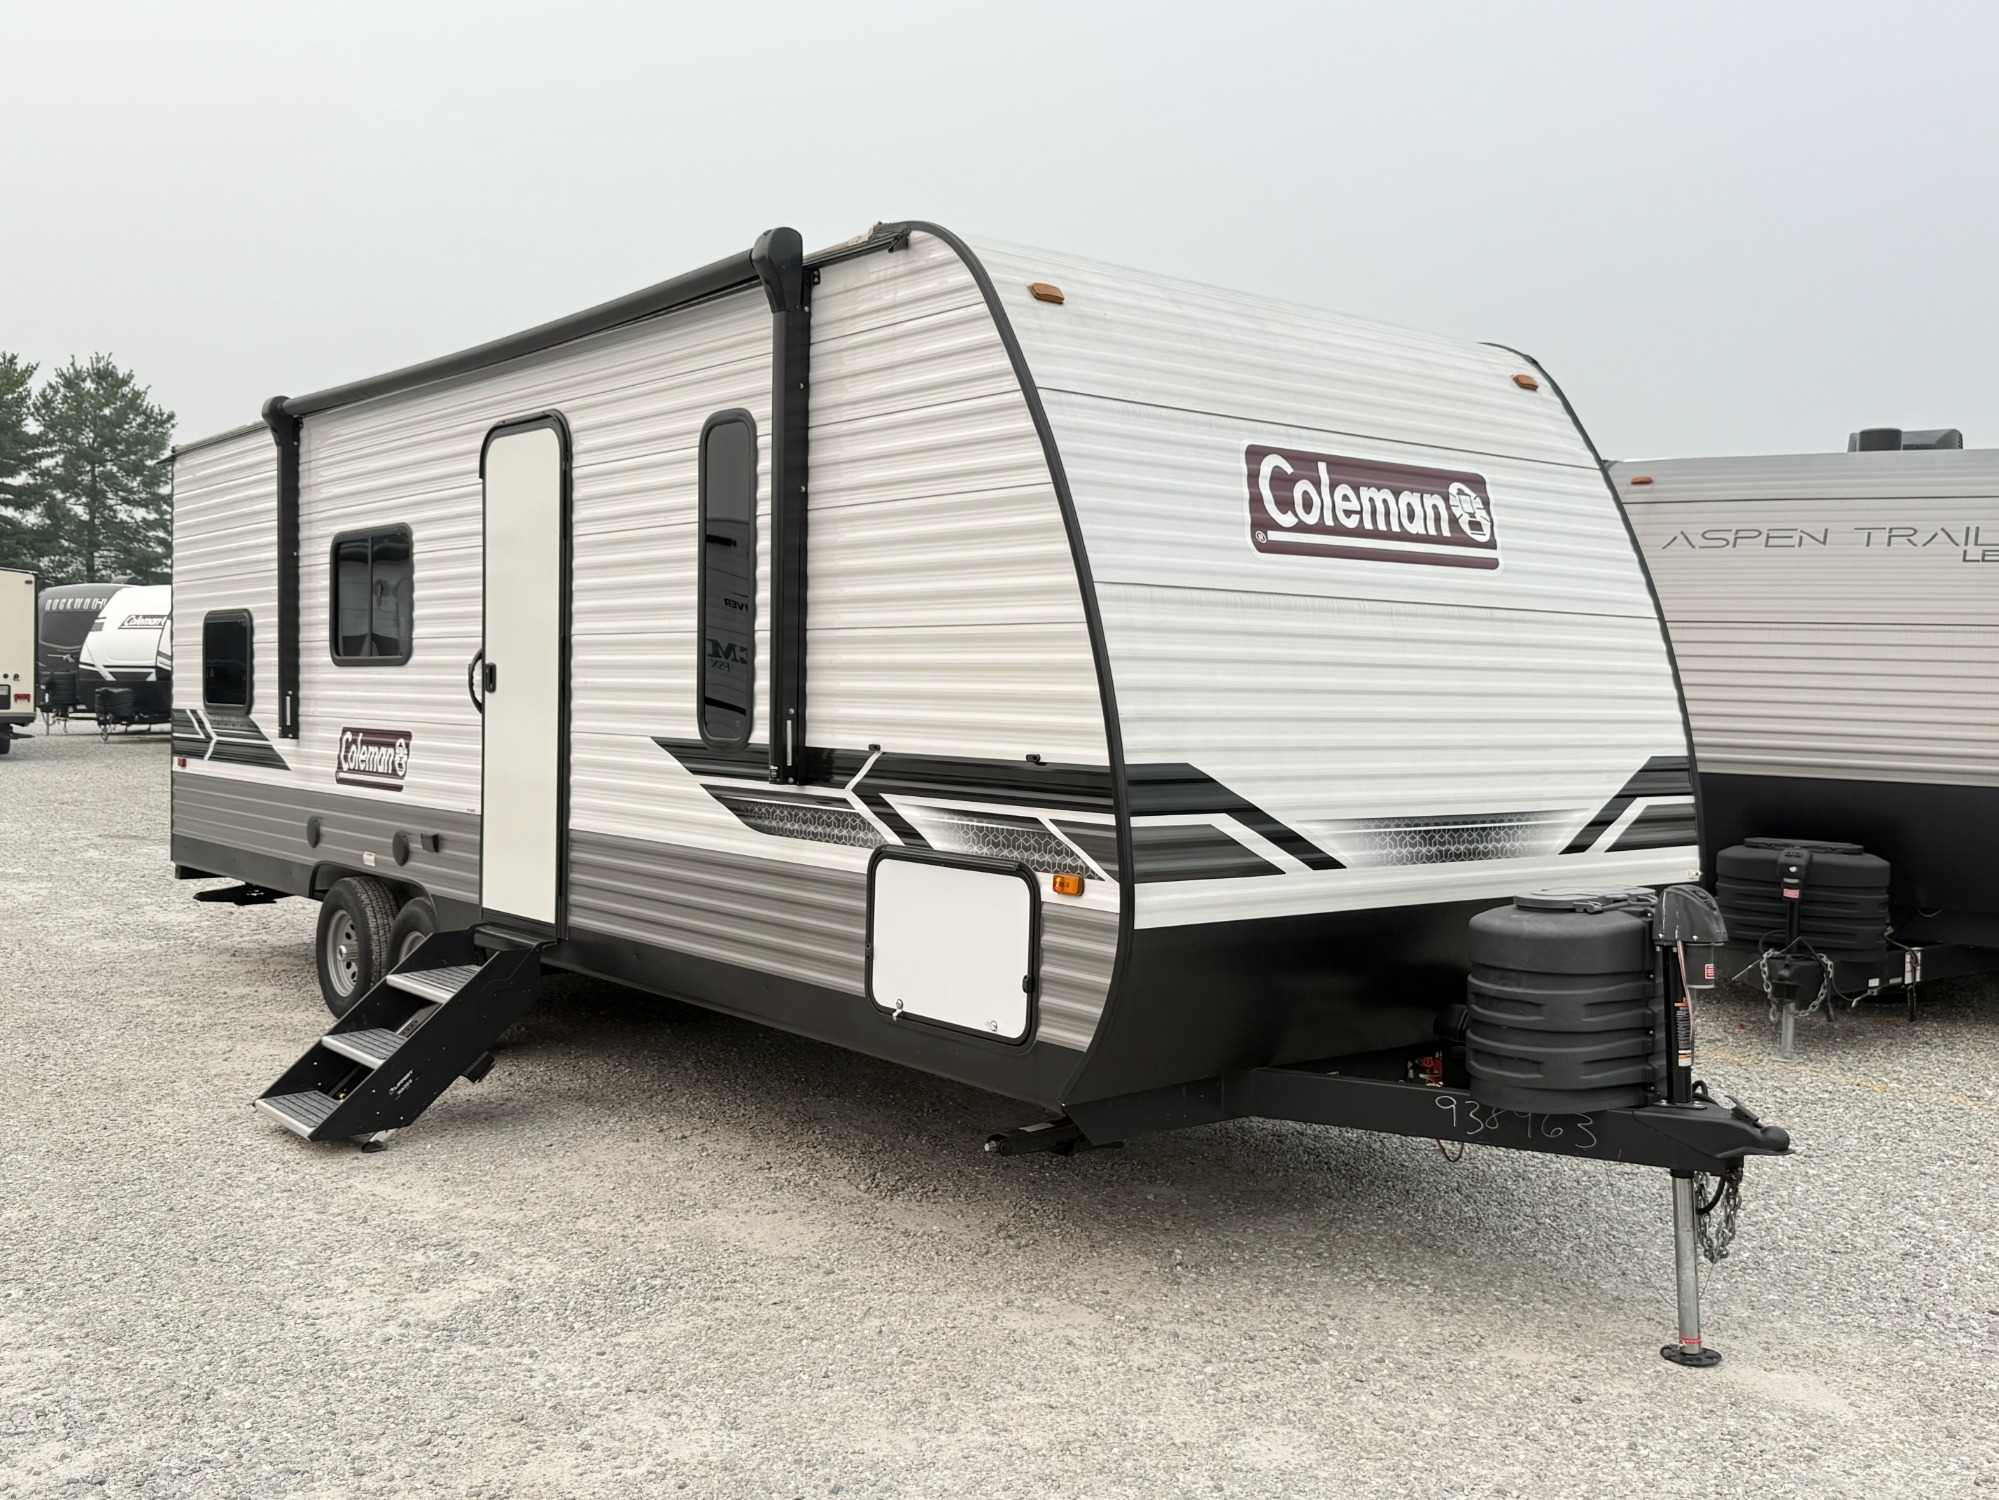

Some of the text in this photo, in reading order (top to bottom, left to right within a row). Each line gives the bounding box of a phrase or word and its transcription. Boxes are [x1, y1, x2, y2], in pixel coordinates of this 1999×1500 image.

[1258, 453, 1451, 537] Coleman
[1661, 528, 1829, 549] ASPEN
[123, 614, 162, 627] Coleman
[340, 730, 395, 774] Coleman
